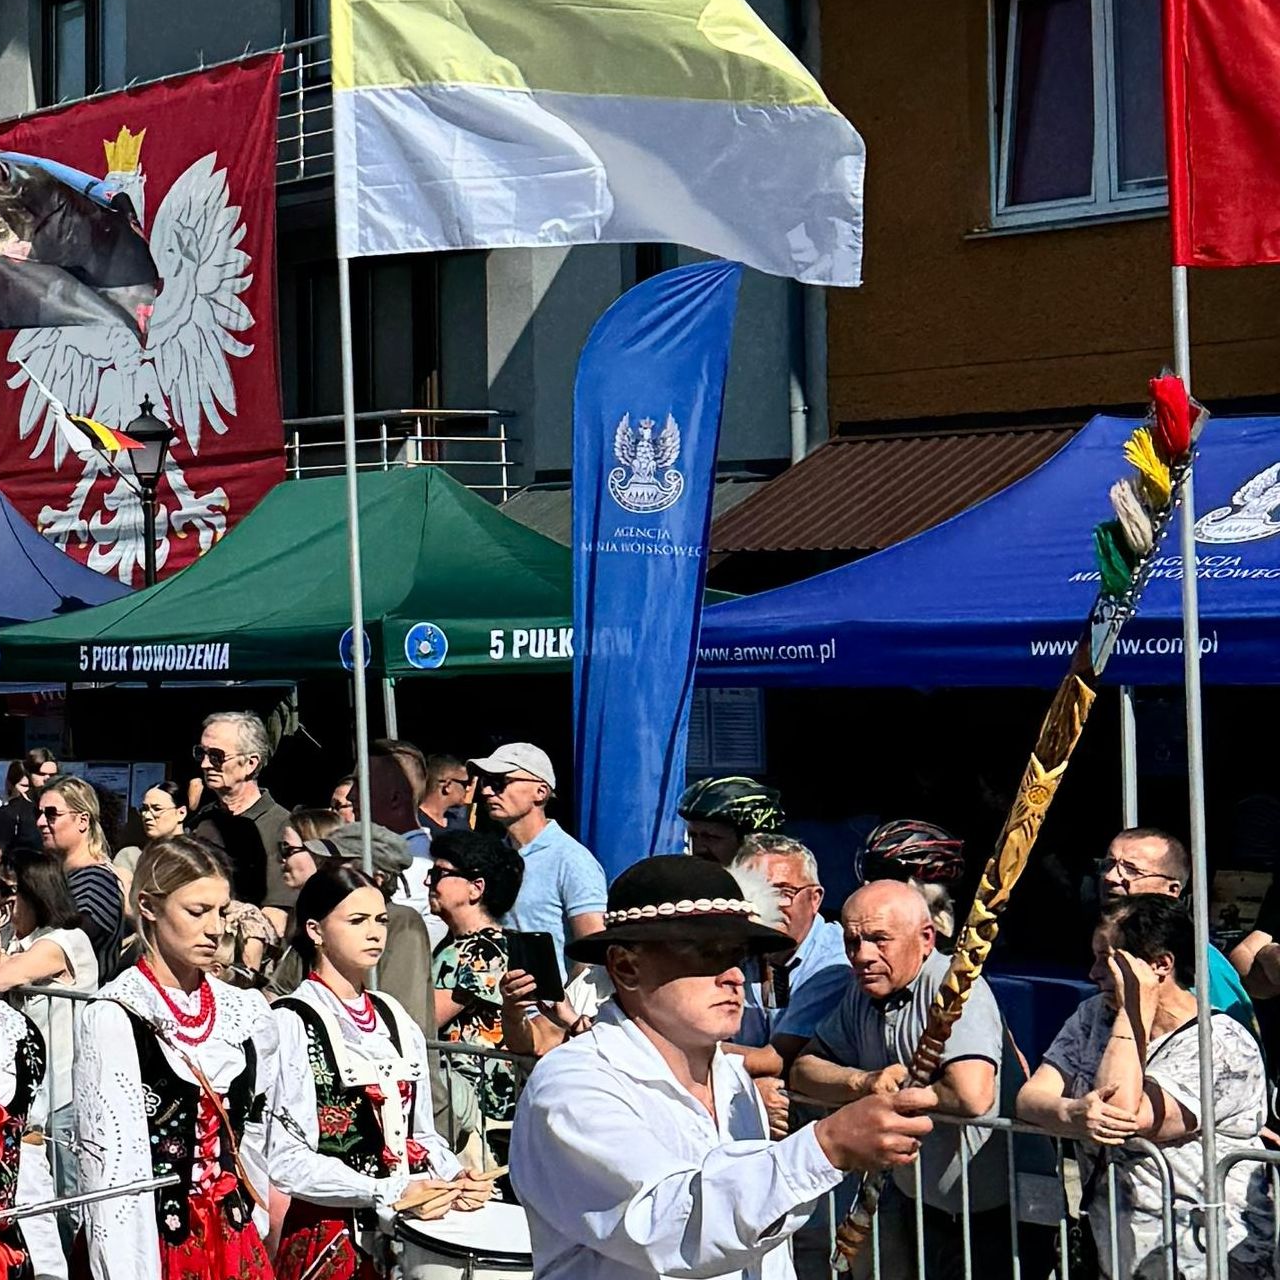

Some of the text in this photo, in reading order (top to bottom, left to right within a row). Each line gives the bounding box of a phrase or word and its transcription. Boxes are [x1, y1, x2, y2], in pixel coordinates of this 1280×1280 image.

[614, 526, 671, 540] AGENCJA
[621, 542, 702, 557] WOJSKOWEG
[1148, 556, 1241, 567] AGNCJA
[79, 646, 89, 670] 5
[132, 643, 230, 670] DOWODZENIA
[490, 630, 504, 659] 5
[512, 628, 574, 658] PUŁK
[698, 638, 836, 664] ww.amw.com.pl
[1031, 630, 1218, 657] wwwmw.compl
